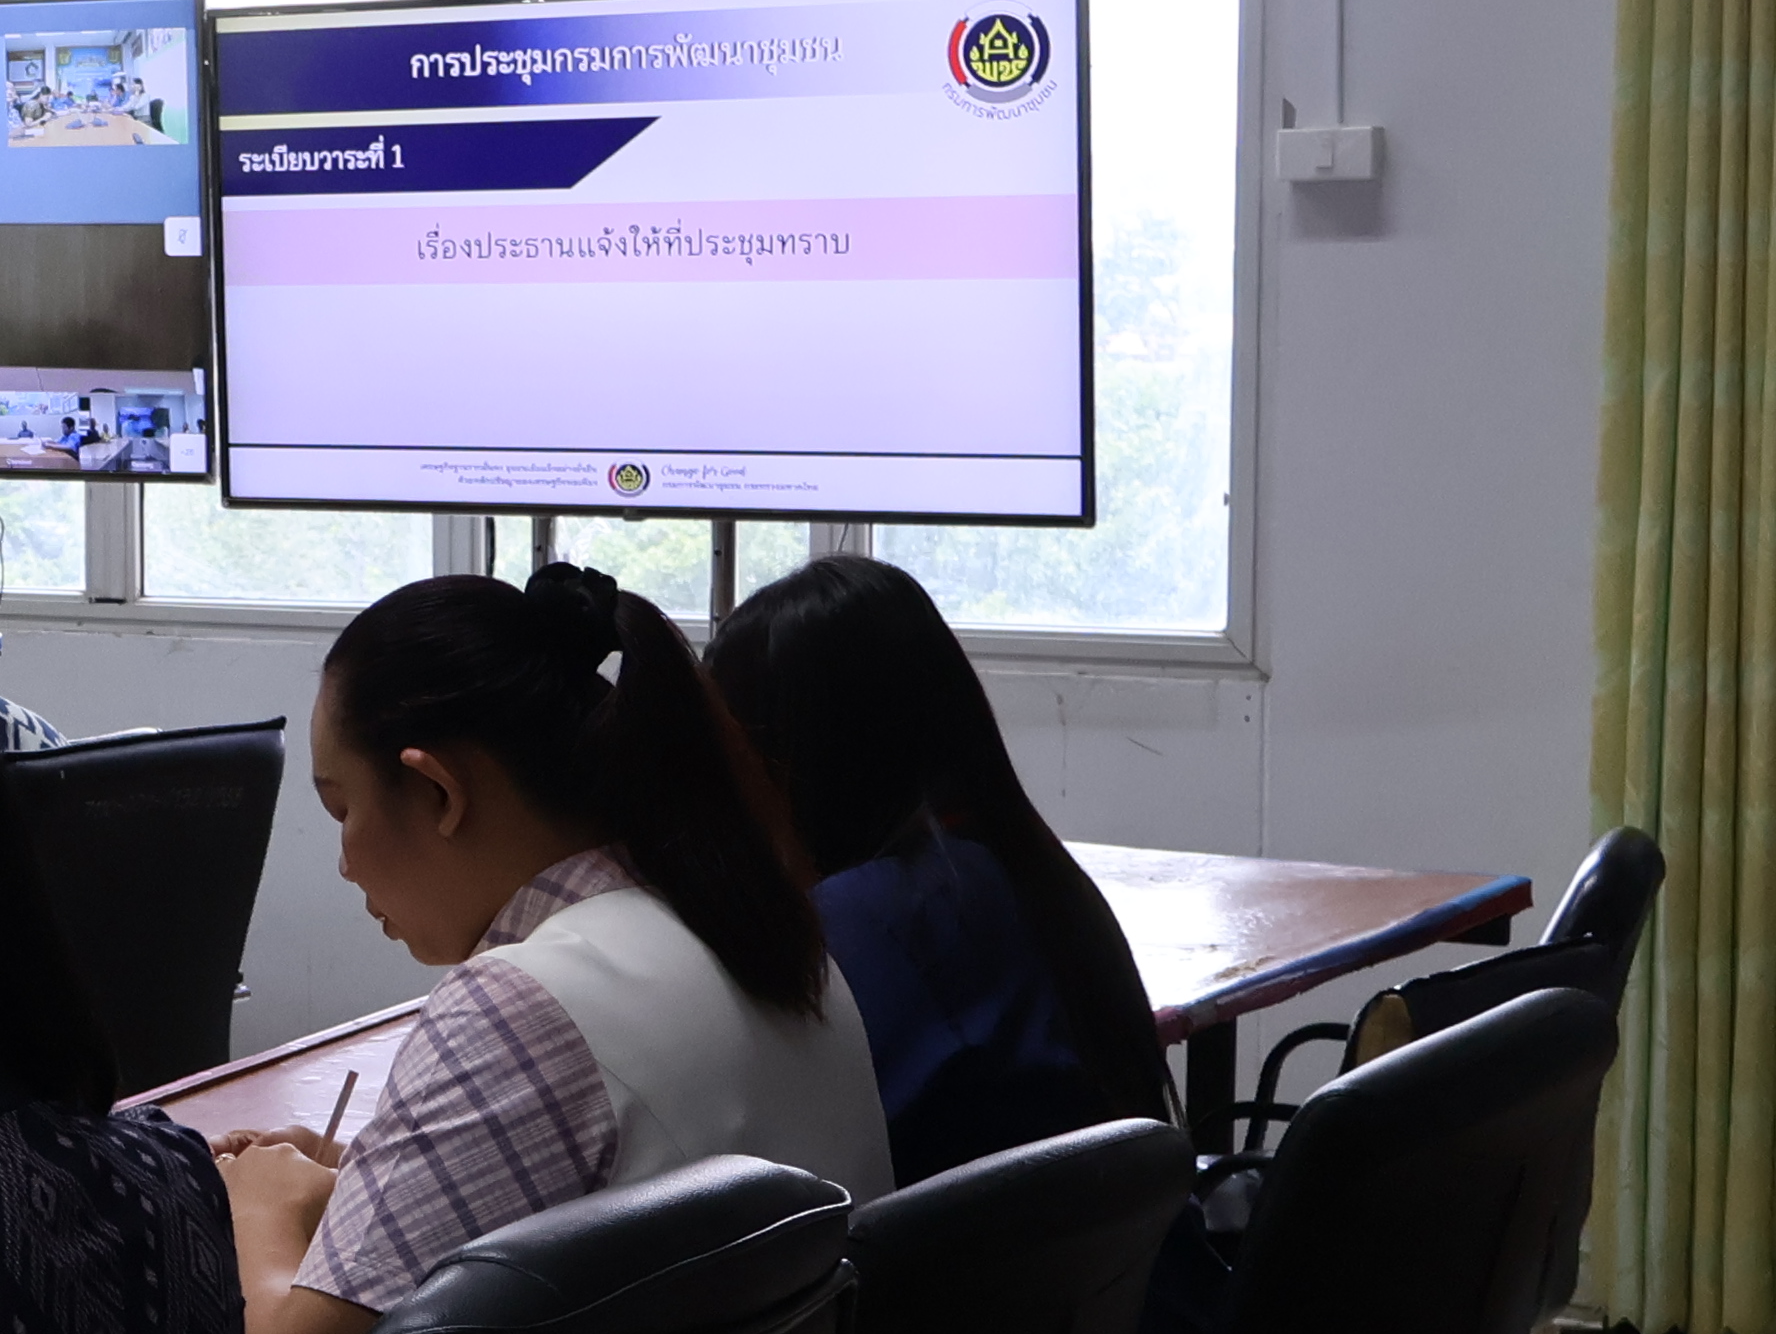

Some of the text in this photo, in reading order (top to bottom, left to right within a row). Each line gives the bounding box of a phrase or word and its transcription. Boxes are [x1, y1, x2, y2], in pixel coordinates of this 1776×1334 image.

[410, 29, 846, 87] การประชุมกรมการพัฒนาชุมชน
[238, 140, 405, 174] ระเบียบวาระที่ 1
[416, 220, 852, 267] เรื่องประธานแจ้งให้ที่ประชุมทราบ
